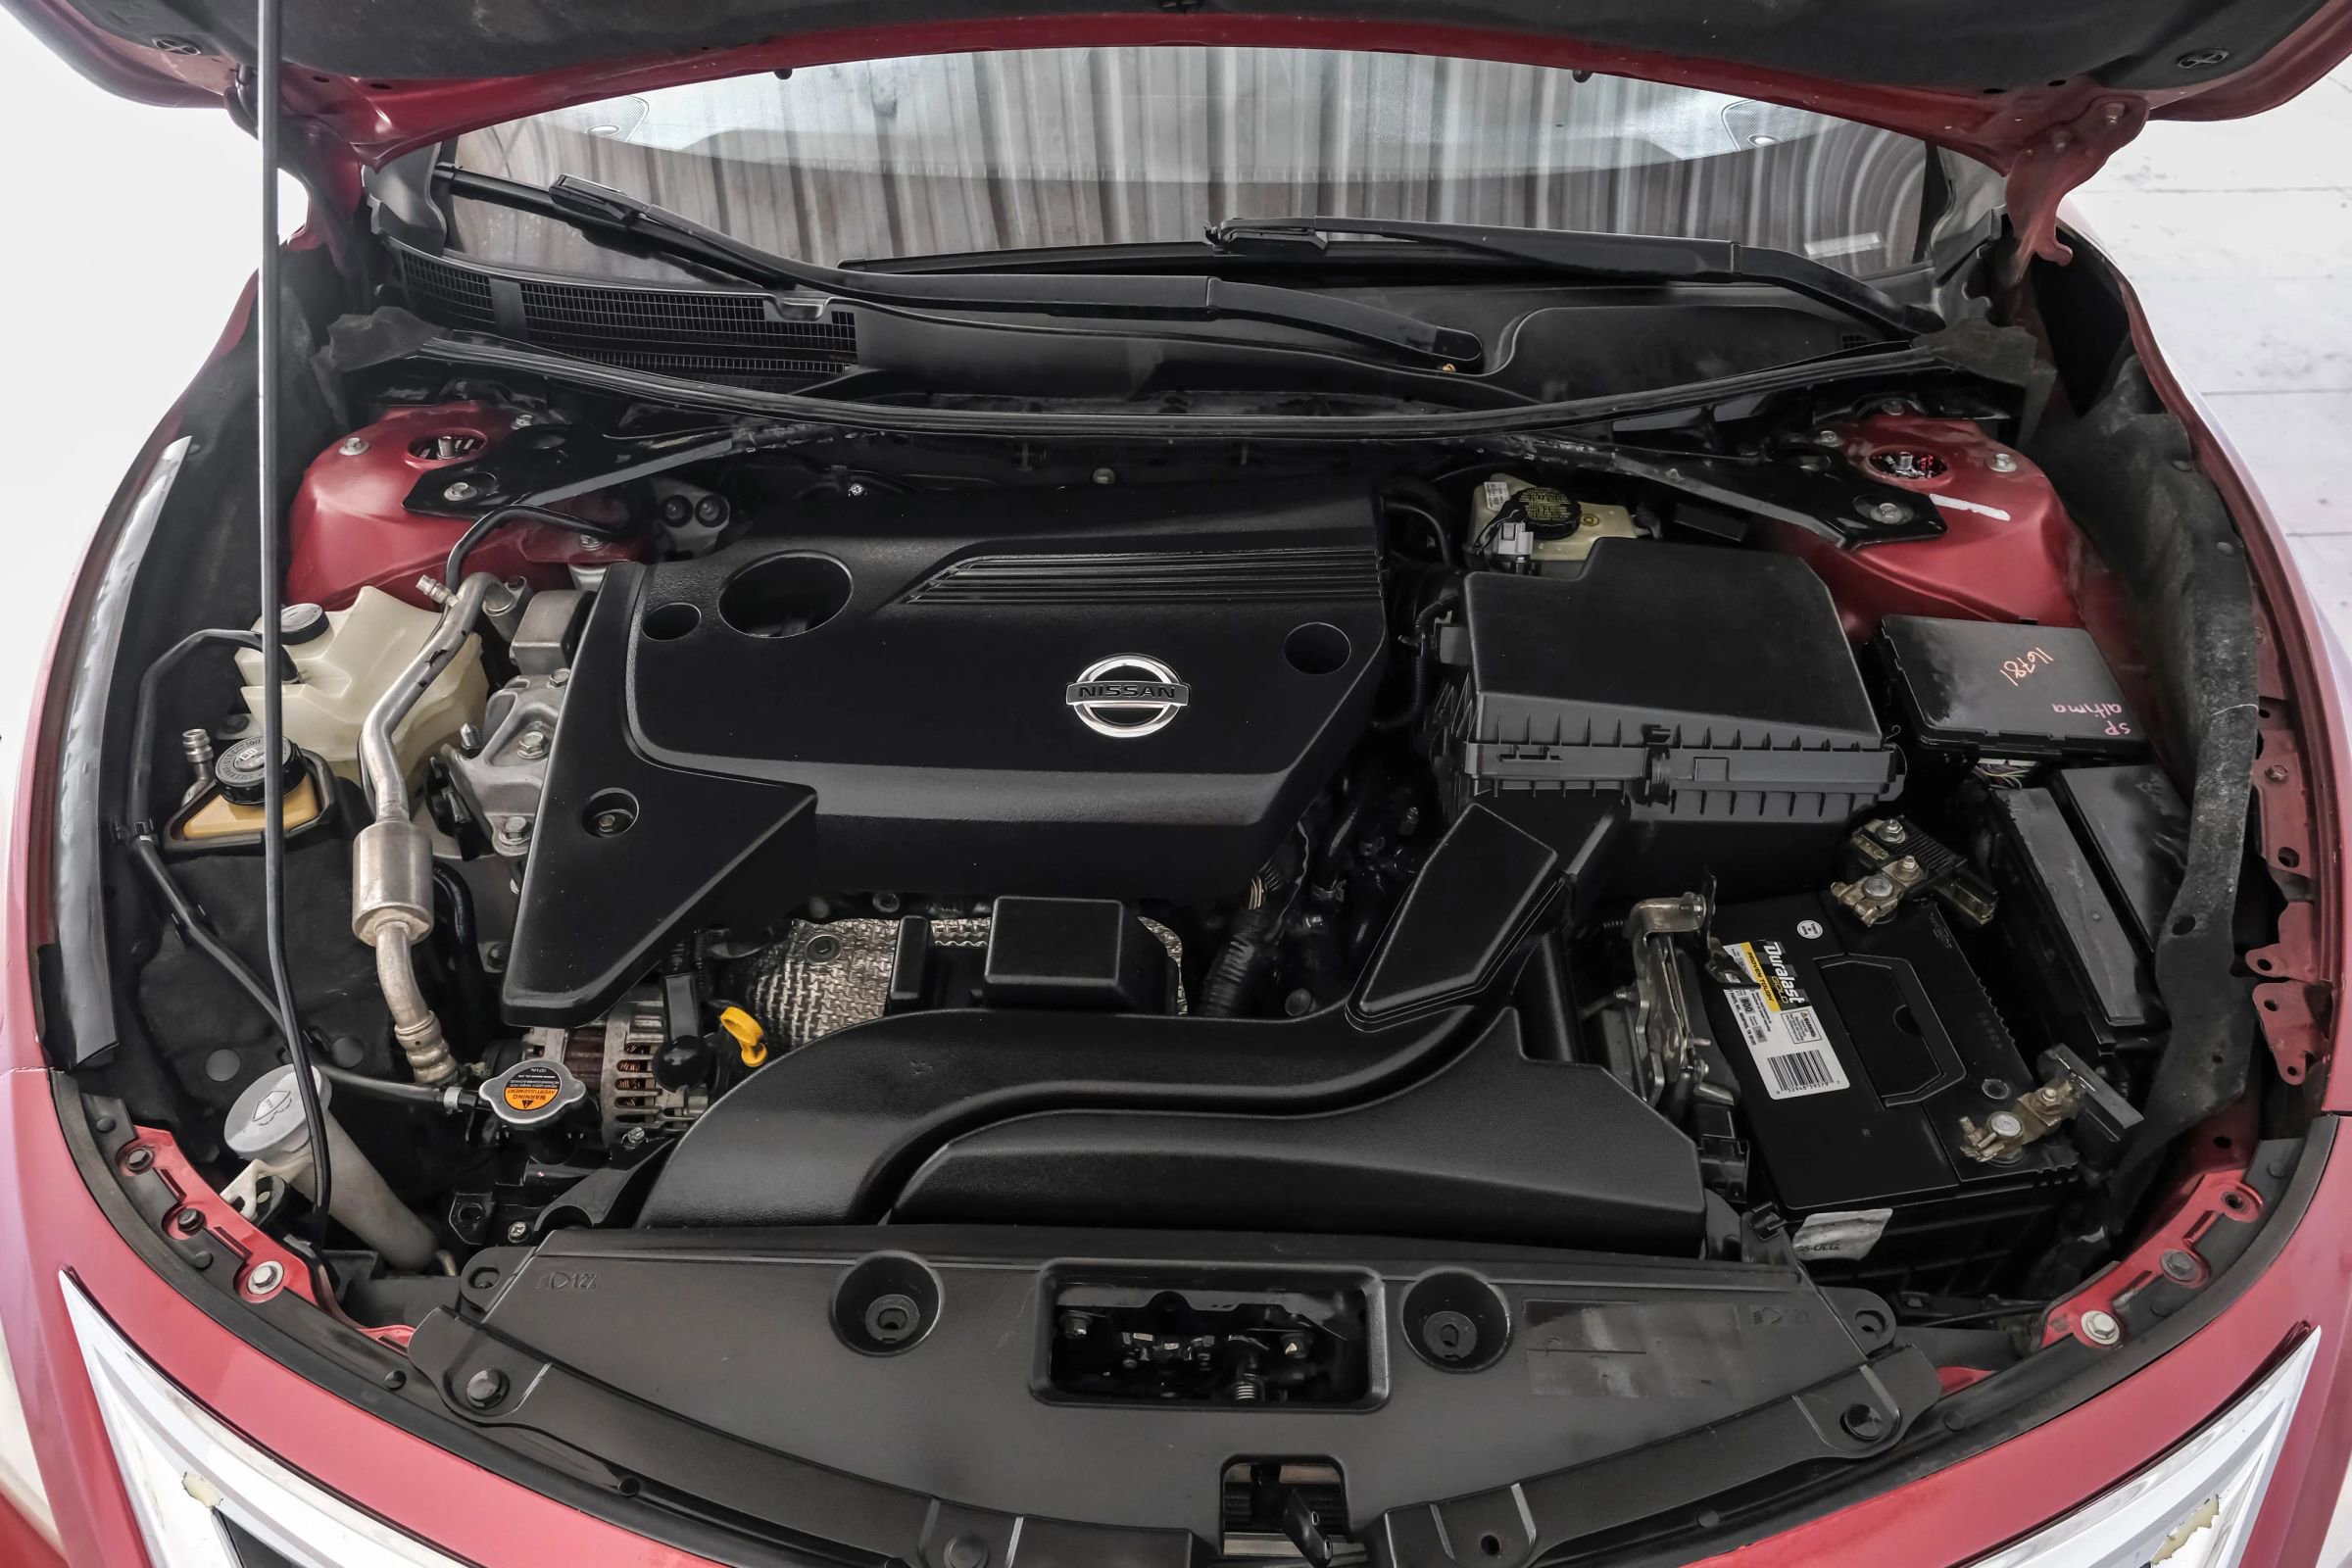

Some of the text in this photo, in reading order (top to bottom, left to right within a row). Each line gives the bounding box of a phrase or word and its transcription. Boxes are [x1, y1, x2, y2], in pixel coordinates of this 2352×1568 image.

[1078, 685, 1176, 699] NISSAN
[1746, 952, 1763, 978] PROVEN
[1759, 980, 1774, 1002] TOUGH
[1763, 941, 1805, 1004] Duralast
[1771, 976, 1788, 1004] GOLD
